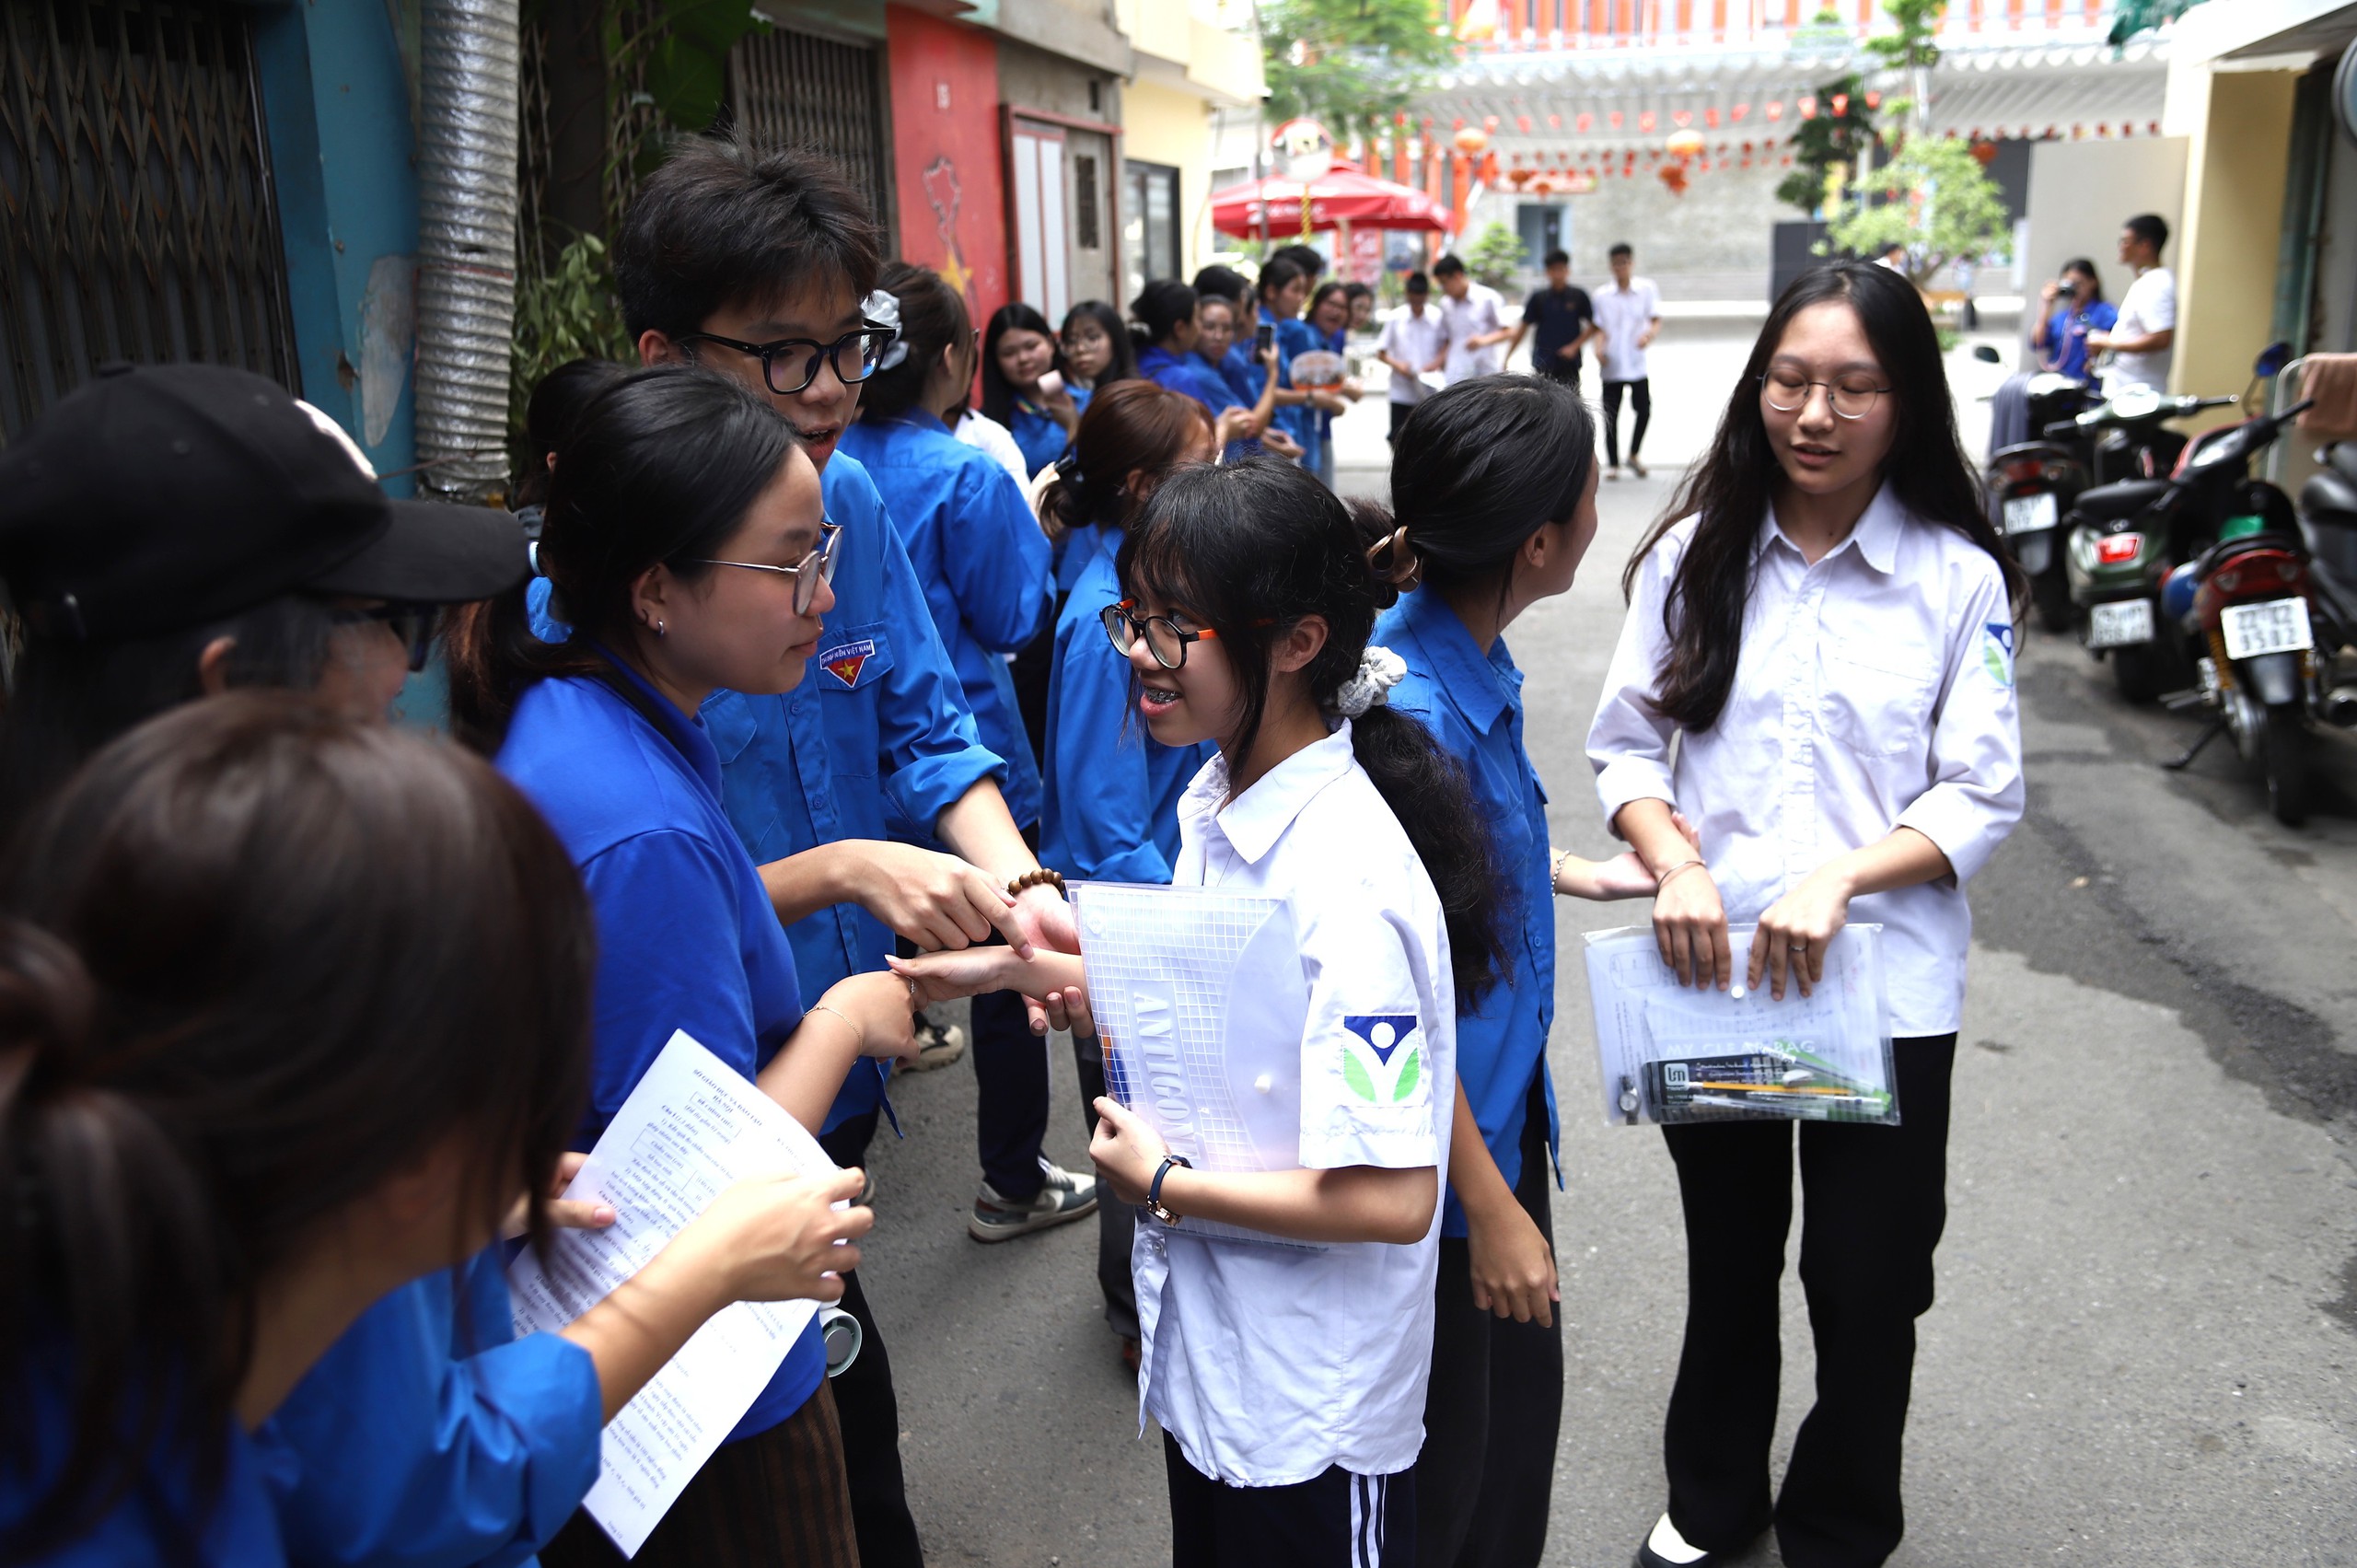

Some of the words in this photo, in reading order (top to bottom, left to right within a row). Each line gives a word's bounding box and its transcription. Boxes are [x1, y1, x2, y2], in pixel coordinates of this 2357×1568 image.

[936, 82, 951, 110] 15
[847, 646, 858, 656] VIỆT
[858, 644, 872, 653] NAM
[1666, 1043, 1694, 1056] MY
[1773, 1040, 1817, 1054] BAG
[1134, 992, 1201, 1160] ANTIGONE
